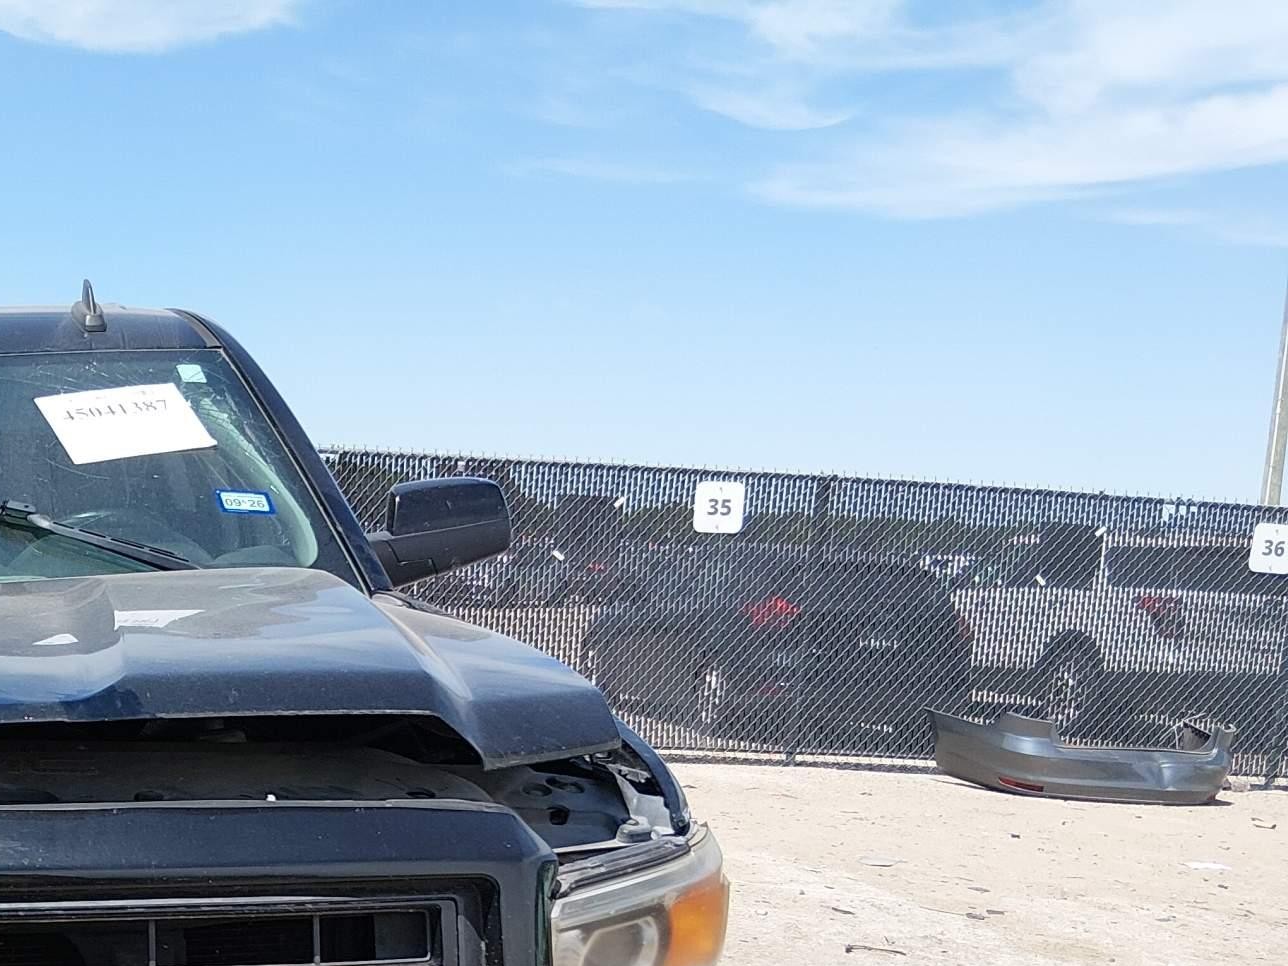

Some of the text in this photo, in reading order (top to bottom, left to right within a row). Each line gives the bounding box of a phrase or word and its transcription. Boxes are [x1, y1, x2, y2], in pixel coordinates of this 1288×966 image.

[64, 399, 168, 421] 45041387
[707, 498, 732, 516] 35
[1262, 539, 1285, 557] 36
